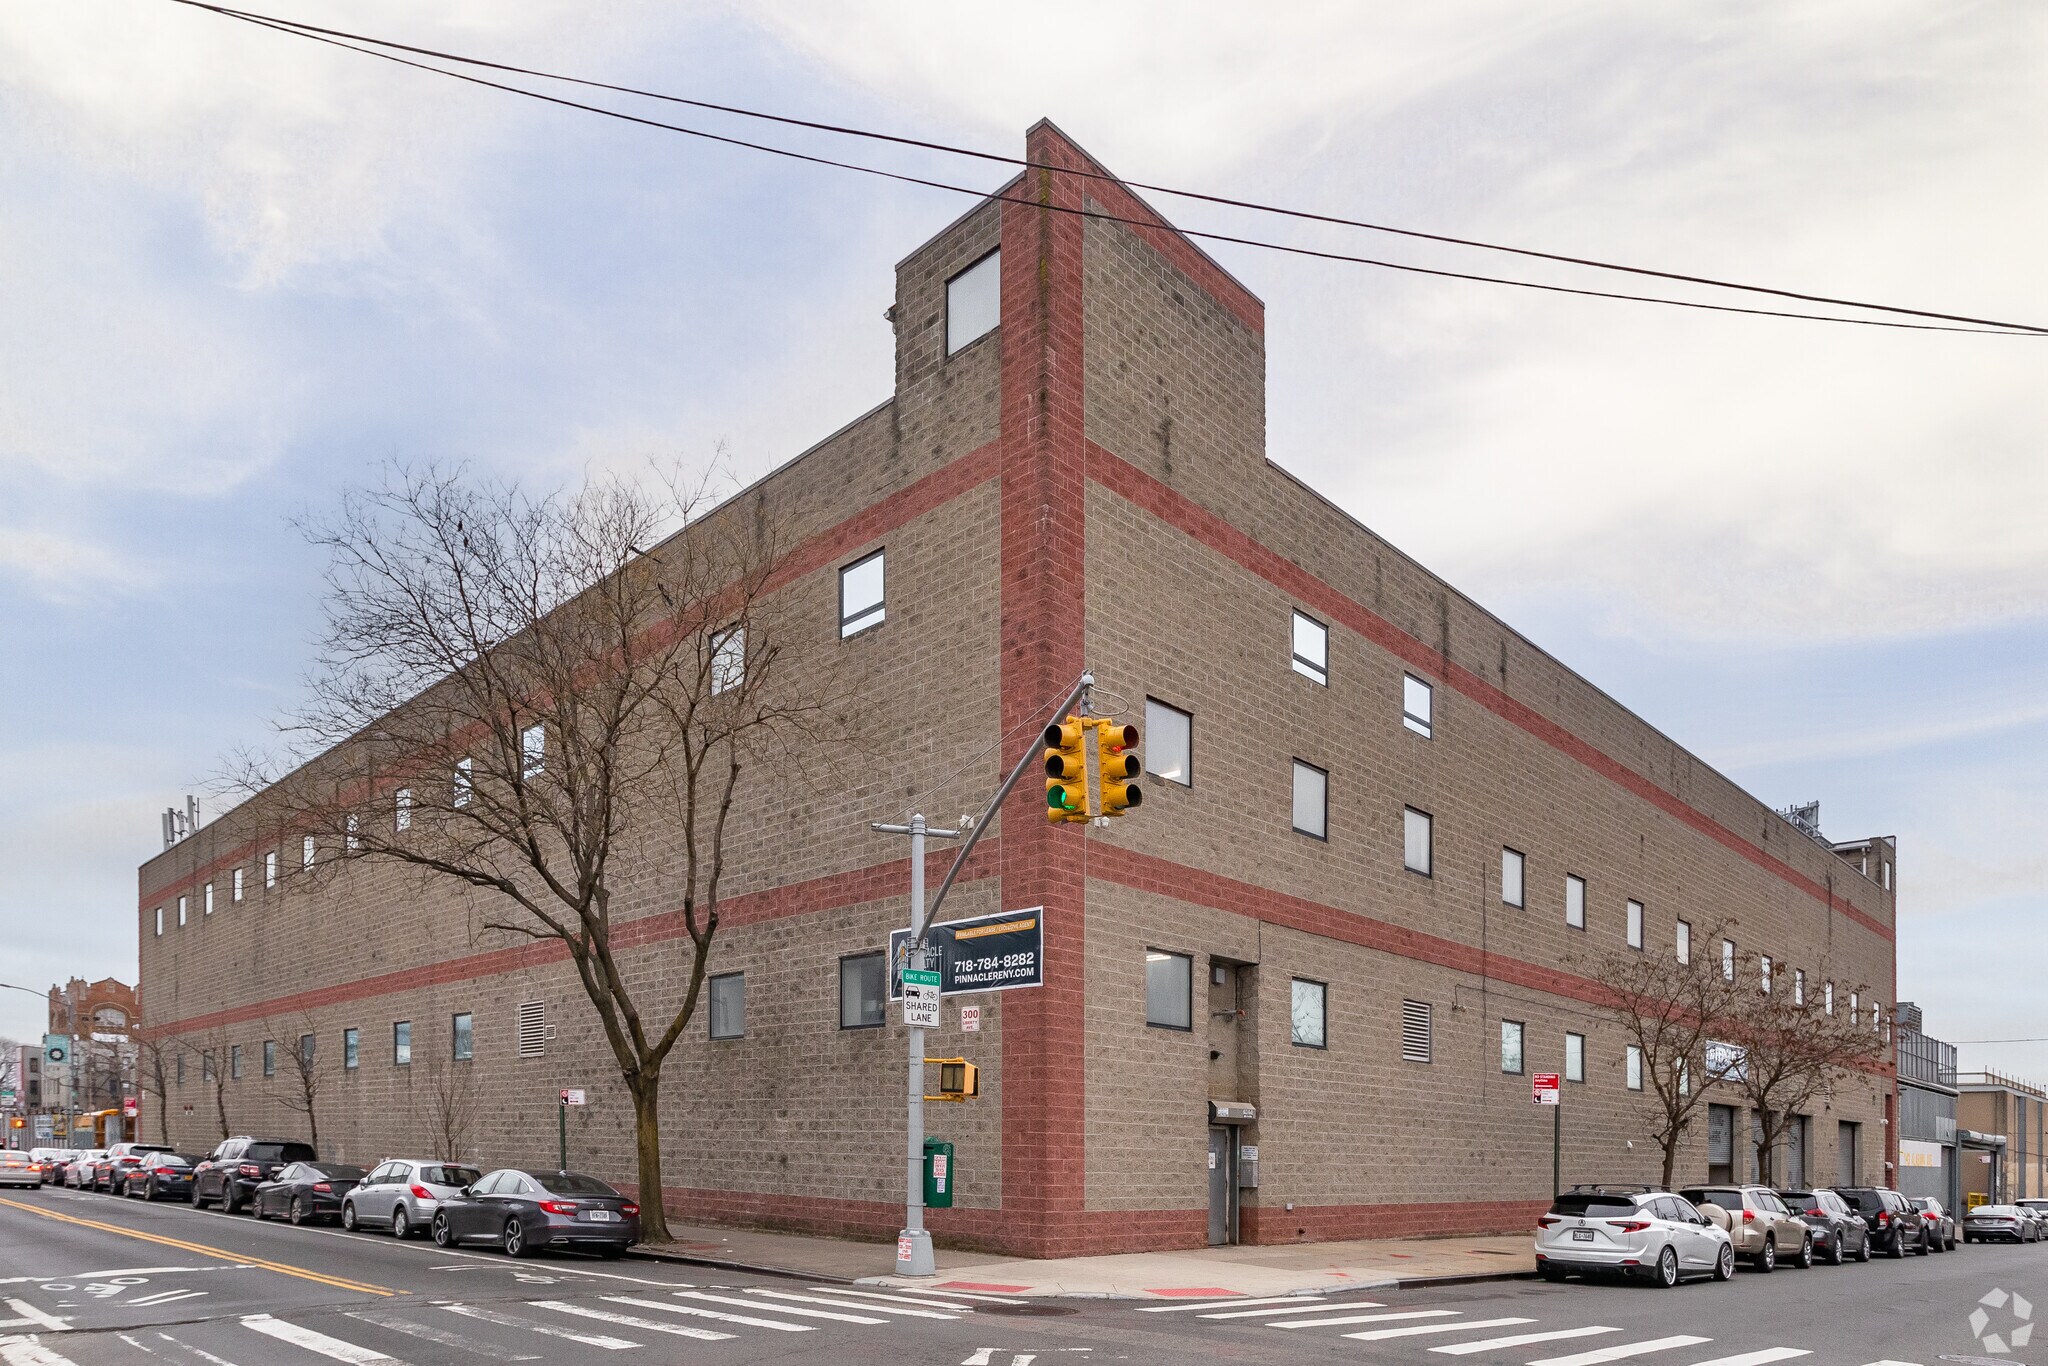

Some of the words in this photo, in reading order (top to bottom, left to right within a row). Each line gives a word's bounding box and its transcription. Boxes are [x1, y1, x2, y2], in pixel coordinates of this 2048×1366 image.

[1019, 921, 1033, 929] AGENT
[954, 952, 1034, 973] 718-784-8282
[905, 972, 918, 981] BIKE
[920, 975, 938, 983] ROUTE
[954, 967, 1034, 984] PINNACLERENY.COM
[906, 1001, 938, 1012] SHARED
[911, 1012, 932, 1022] LANE
[962, 1009, 979, 1019] 300
